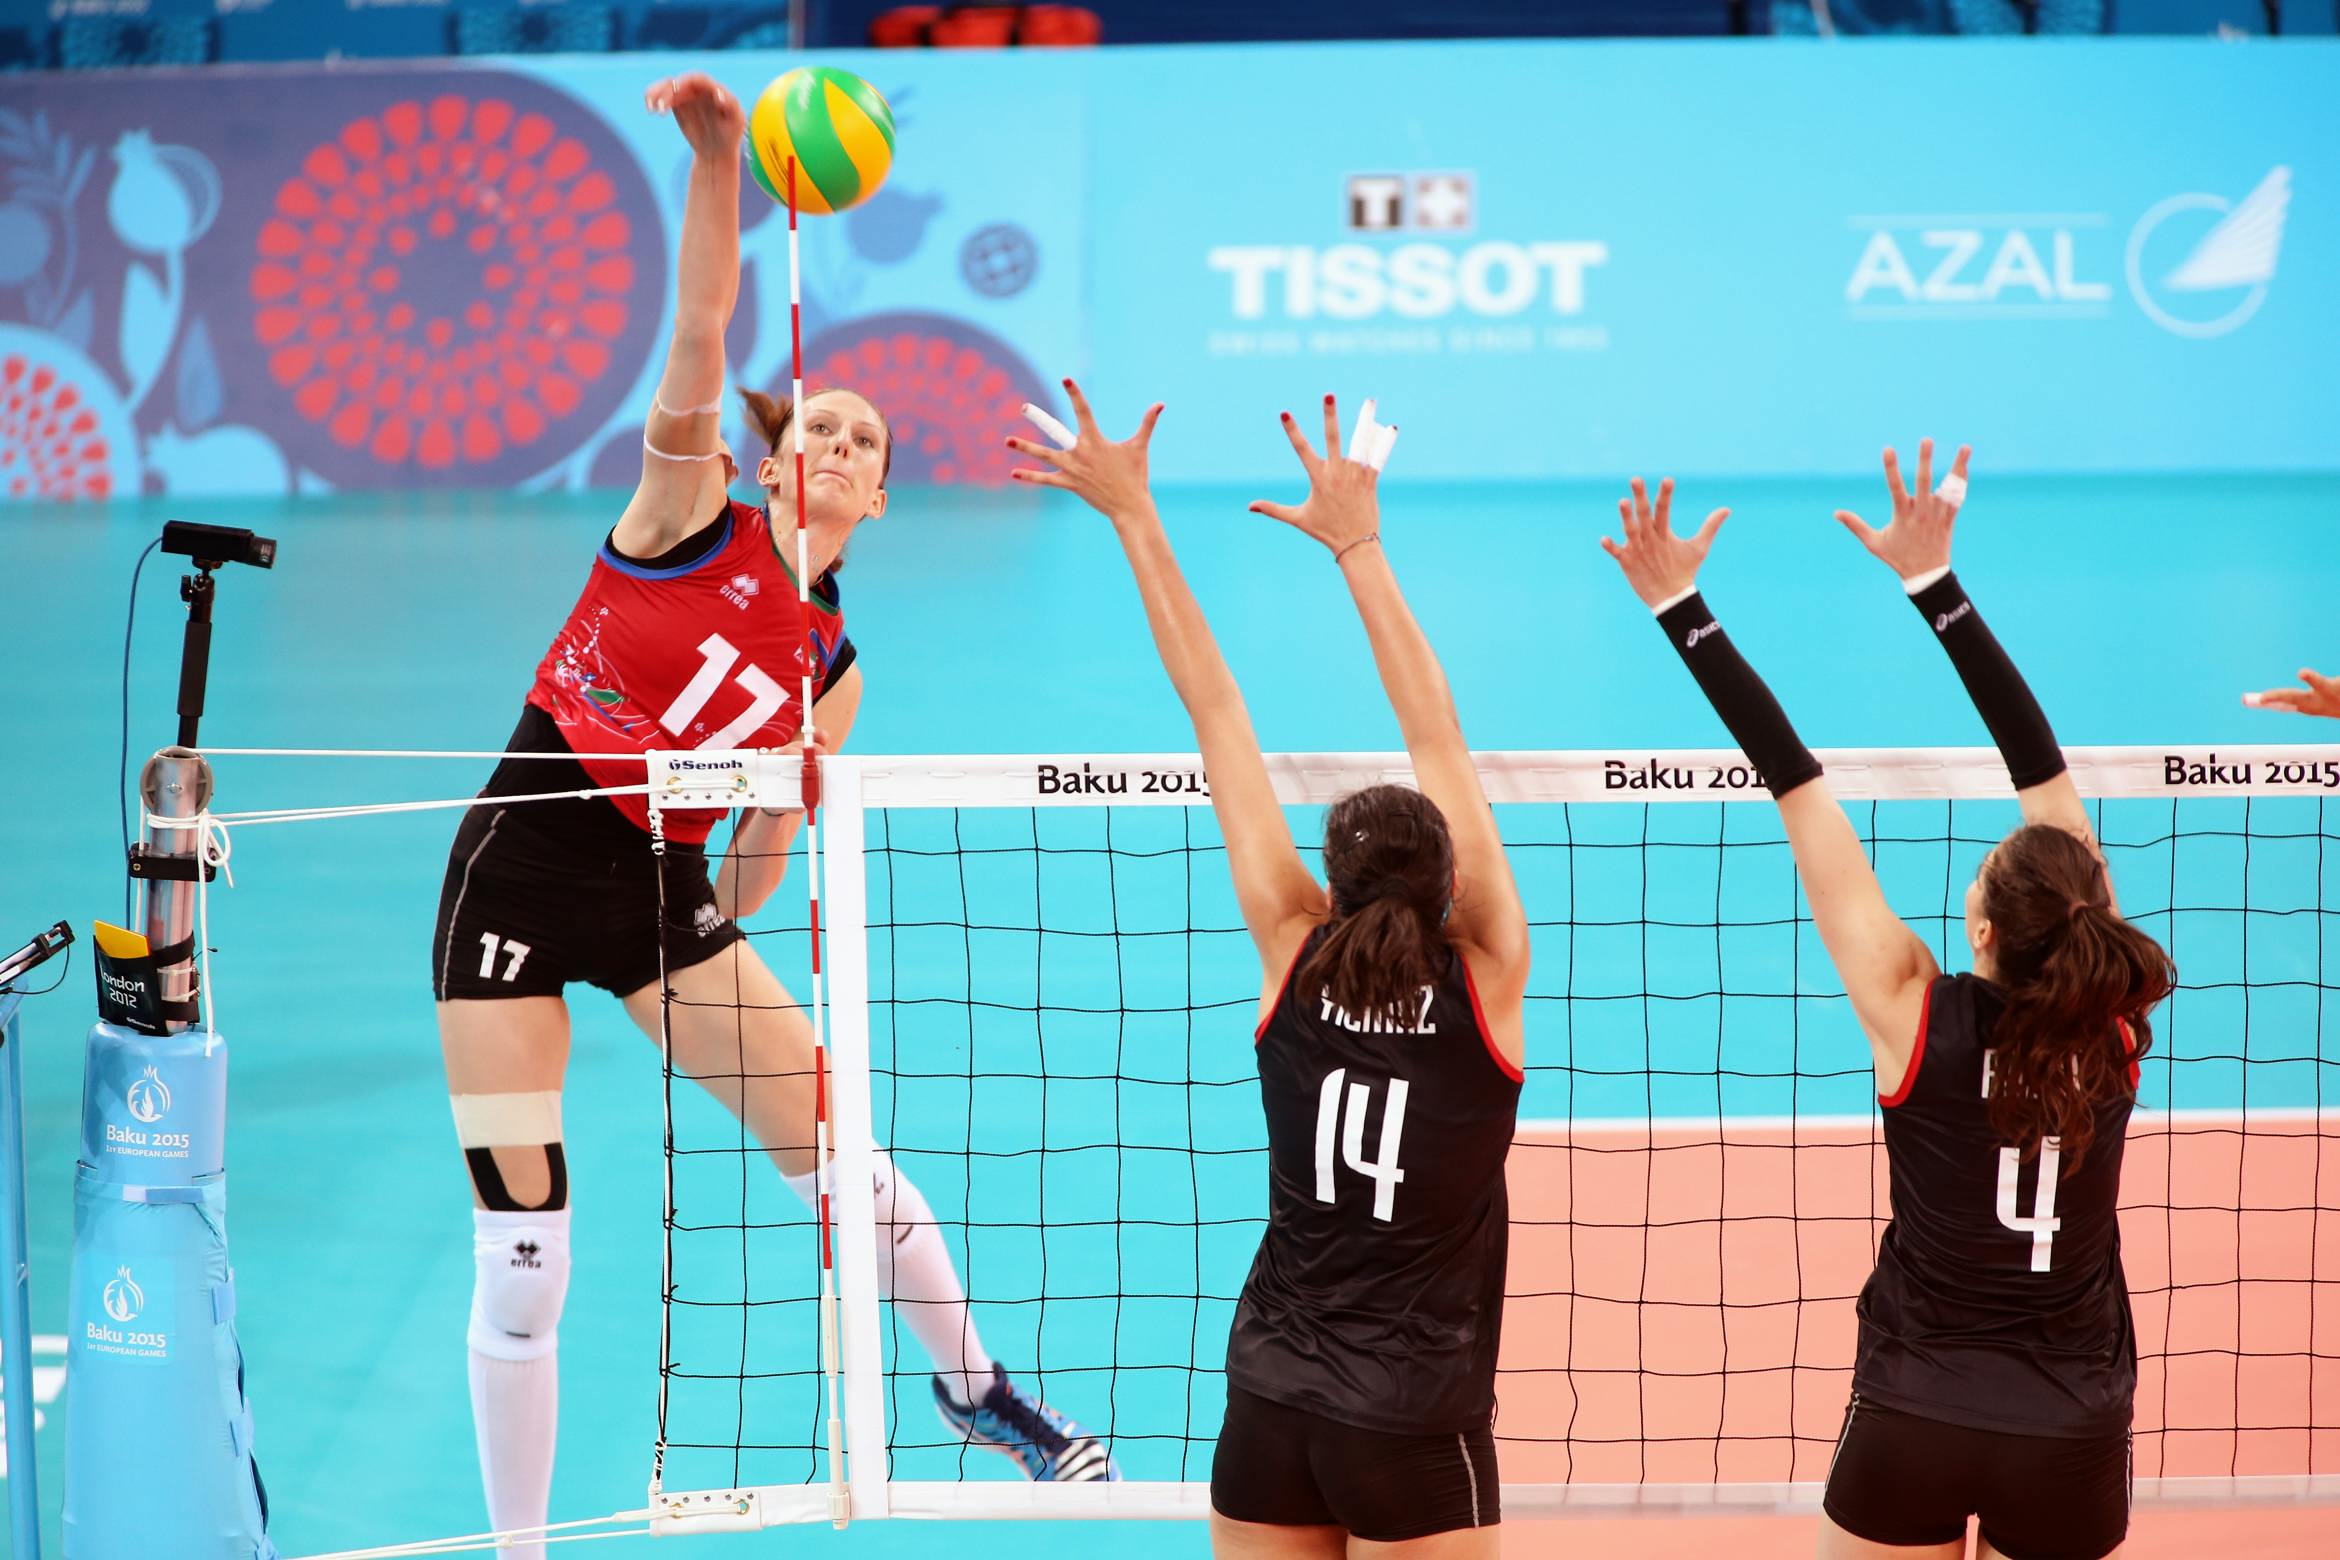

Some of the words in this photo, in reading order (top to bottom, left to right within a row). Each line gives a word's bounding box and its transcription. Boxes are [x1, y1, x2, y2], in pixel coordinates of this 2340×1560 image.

[1208, 241, 1608, 319] TISSOT
[1845, 230, 2112, 301] AZAL
[658, 632, 791, 750] 17
[682, 759, 743, 770] Senoh
[1037, 762, 1128, 795] Baku
[1604, 758, 1694, 790] Baku
[1707, 765, 1768, 789] 201
[2164, 753, 2252, 785] Baku
[2265, 760, 2340, 788] 2015
[479, 931, 532, 982] 17
[109, 987, 138, 1009] 2012
[106, 1124, 147, 1145] Baku
[151, 1133, 190, 1149] 2015
[117, 1146, 161, 1158] EUROPEAN
[162, 1150, 189, 1159] GAMES
[1315, 1067, 1410, 1223] 14
[1996, 1136, 2061, 1272] 4
[87, 1321, 123, 1344] Baku
[127, 1332, 166, 1349] 2015
